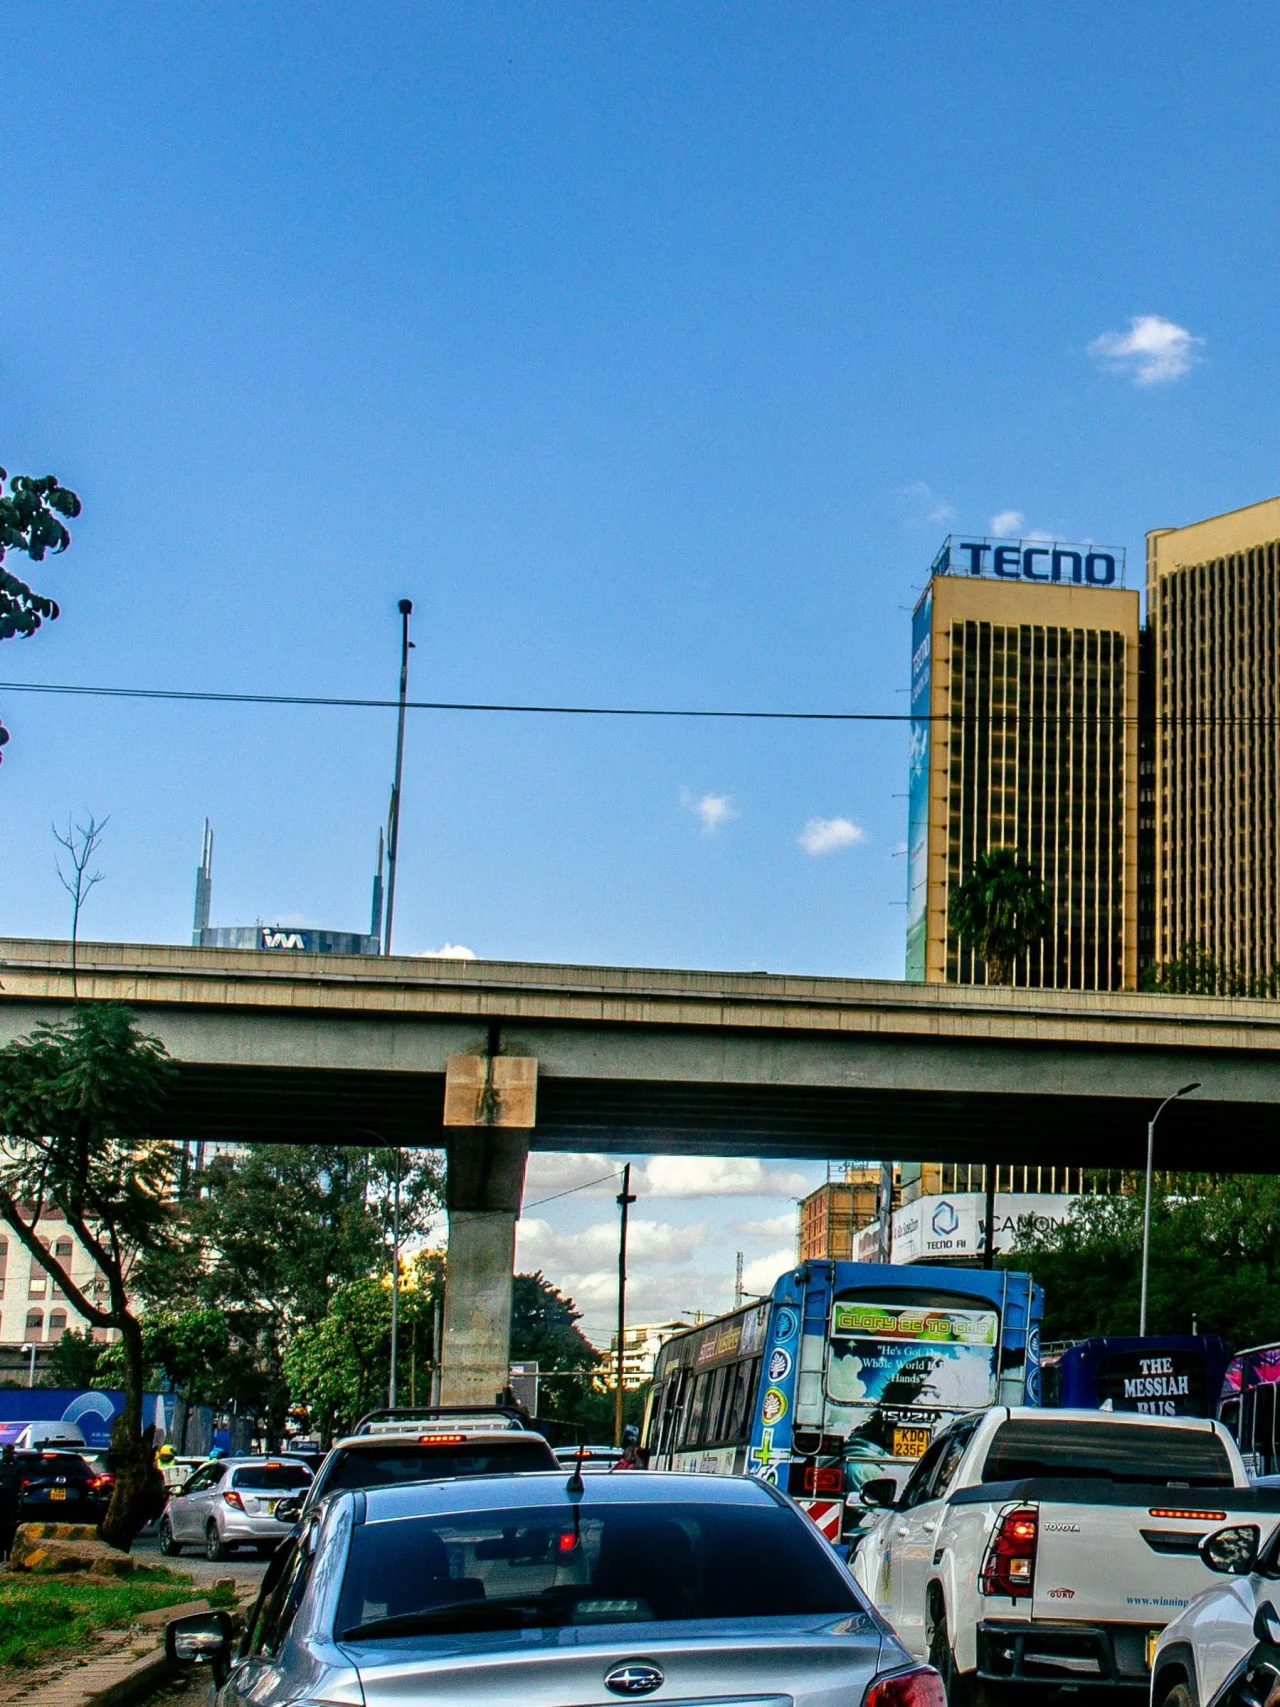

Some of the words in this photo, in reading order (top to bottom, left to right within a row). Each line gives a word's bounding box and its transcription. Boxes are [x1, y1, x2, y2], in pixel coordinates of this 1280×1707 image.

[960, 543, 1115, 585] TECNO
[927, 1240, 953, 1250] TECNO
[839, 1314, 896, 1331] GLORY
[899, 1318, 923, 1333] BE
[927, 1320, 951, 1334] TO
[862, 1358, 893, 1370] Whole
[895, 1359, 925, 1371] World
[1139, 1357, 1173, 1375] THE
[1124, 1375, 1189, 1398] MESSIAH
[1137, 1401, 1176, 1416] BUS
[882, 1410, 936, 1423] ISUZU
[902, 1428, 925, 1443] KDQ
[1044, 1522, 1081, 1533] TOYOTA
